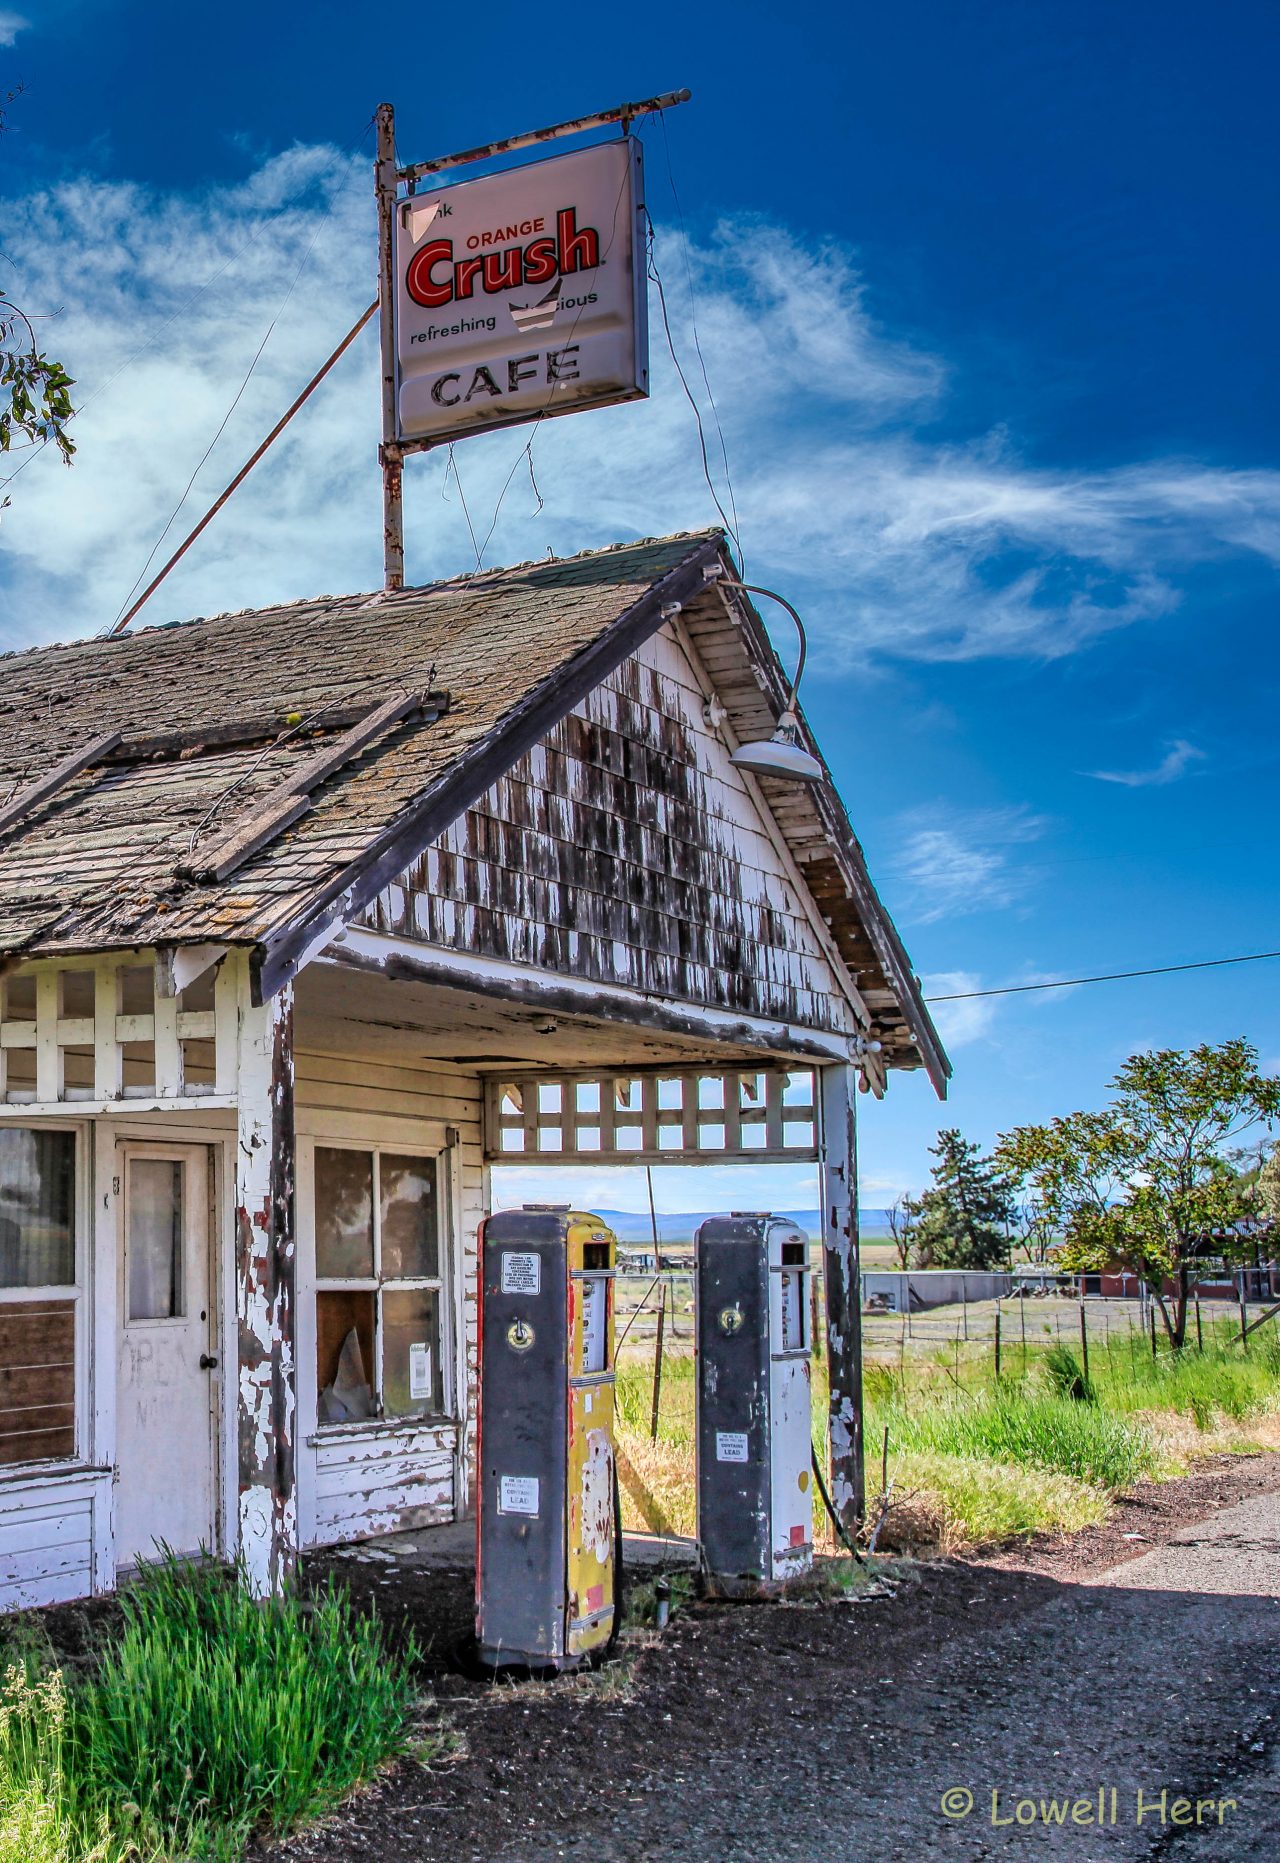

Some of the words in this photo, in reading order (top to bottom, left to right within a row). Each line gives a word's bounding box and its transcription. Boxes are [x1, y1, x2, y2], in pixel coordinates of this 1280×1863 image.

[466, 217, 545, 249] ORANGE
[405, 206, 600, 309] Crush
[410, 316, 496, 345] refreshing
[430, 345, 580, 408] CAFE
